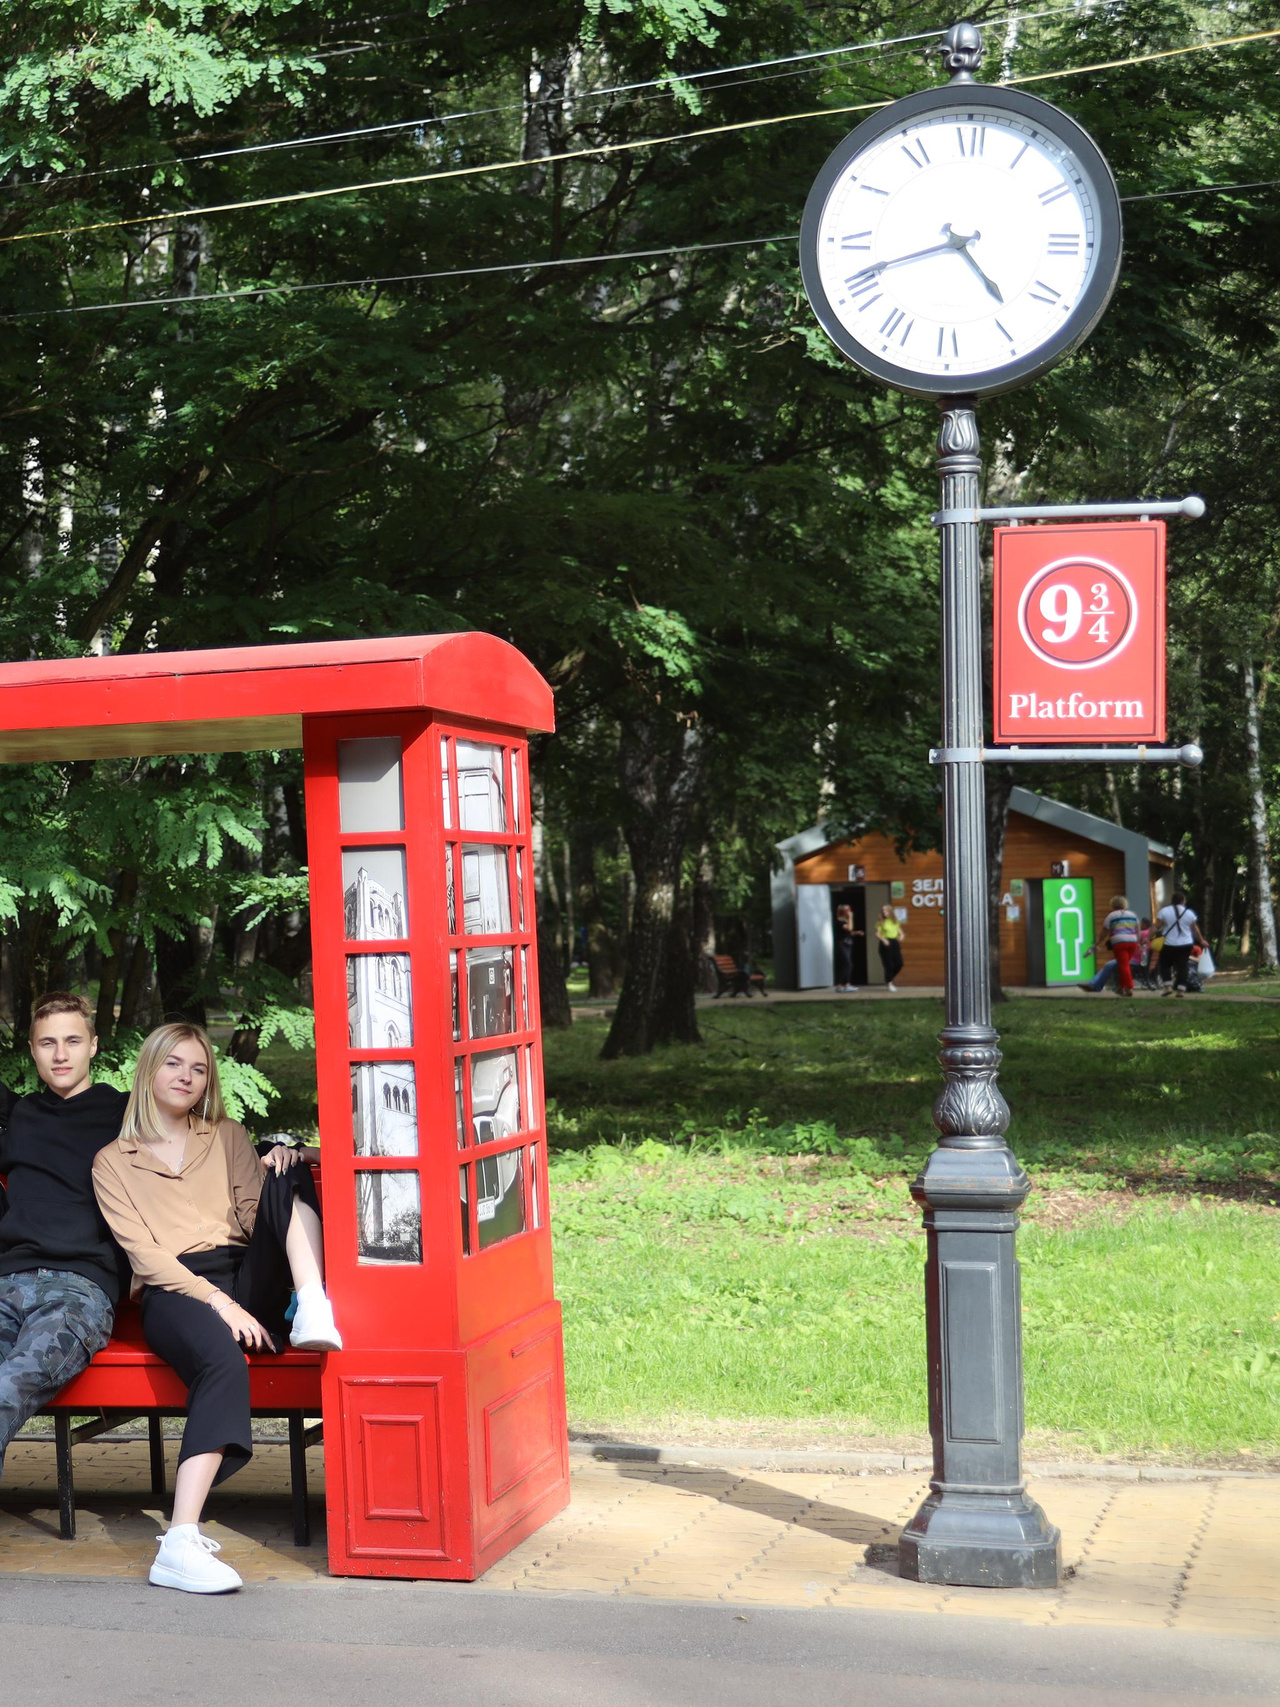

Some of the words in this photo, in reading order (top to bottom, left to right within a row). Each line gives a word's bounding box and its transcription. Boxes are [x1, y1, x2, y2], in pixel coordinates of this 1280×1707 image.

[1039, 584, 1082, 643] 9
[1008, 692, 1144, 719] Platform
[911, 878, 944, 893] ЗЕЛ
[911, 893, 944, 908] ОСТ
